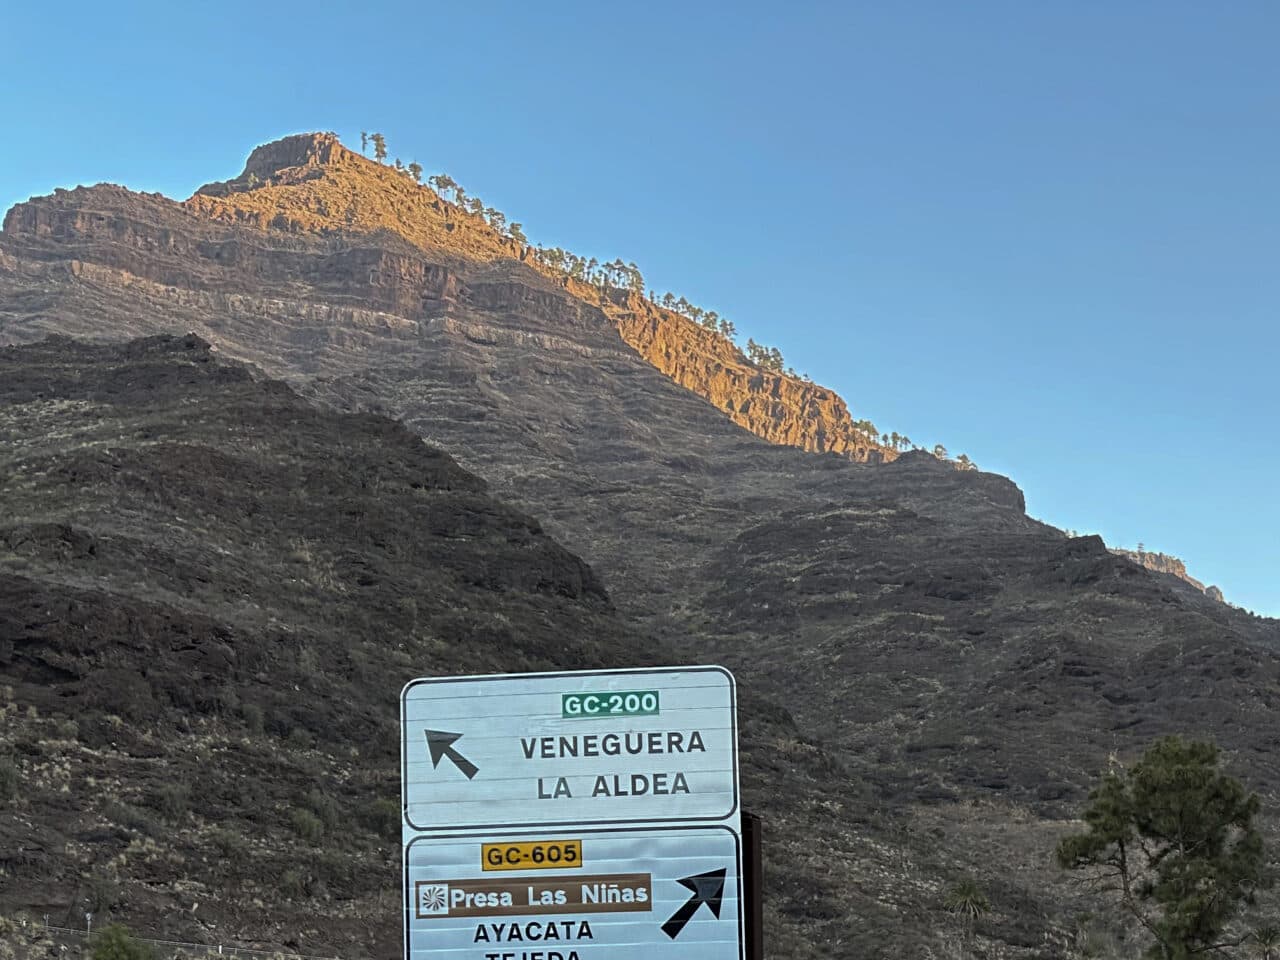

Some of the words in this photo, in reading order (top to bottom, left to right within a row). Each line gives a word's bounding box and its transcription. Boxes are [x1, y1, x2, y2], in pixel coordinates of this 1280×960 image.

[564, 693, 658, 715] GC-200
[537, 777, 572, 800] LA
[591, 772, 691, 798] ALDEA
[487, 844, 577, 865] GC-605
[450, 888, 513, 909] Presa
[527, 886, 567, 906] Las
[581, 883, 649, 904] Niñas
[473, 920, 594, 943] AYACATA
